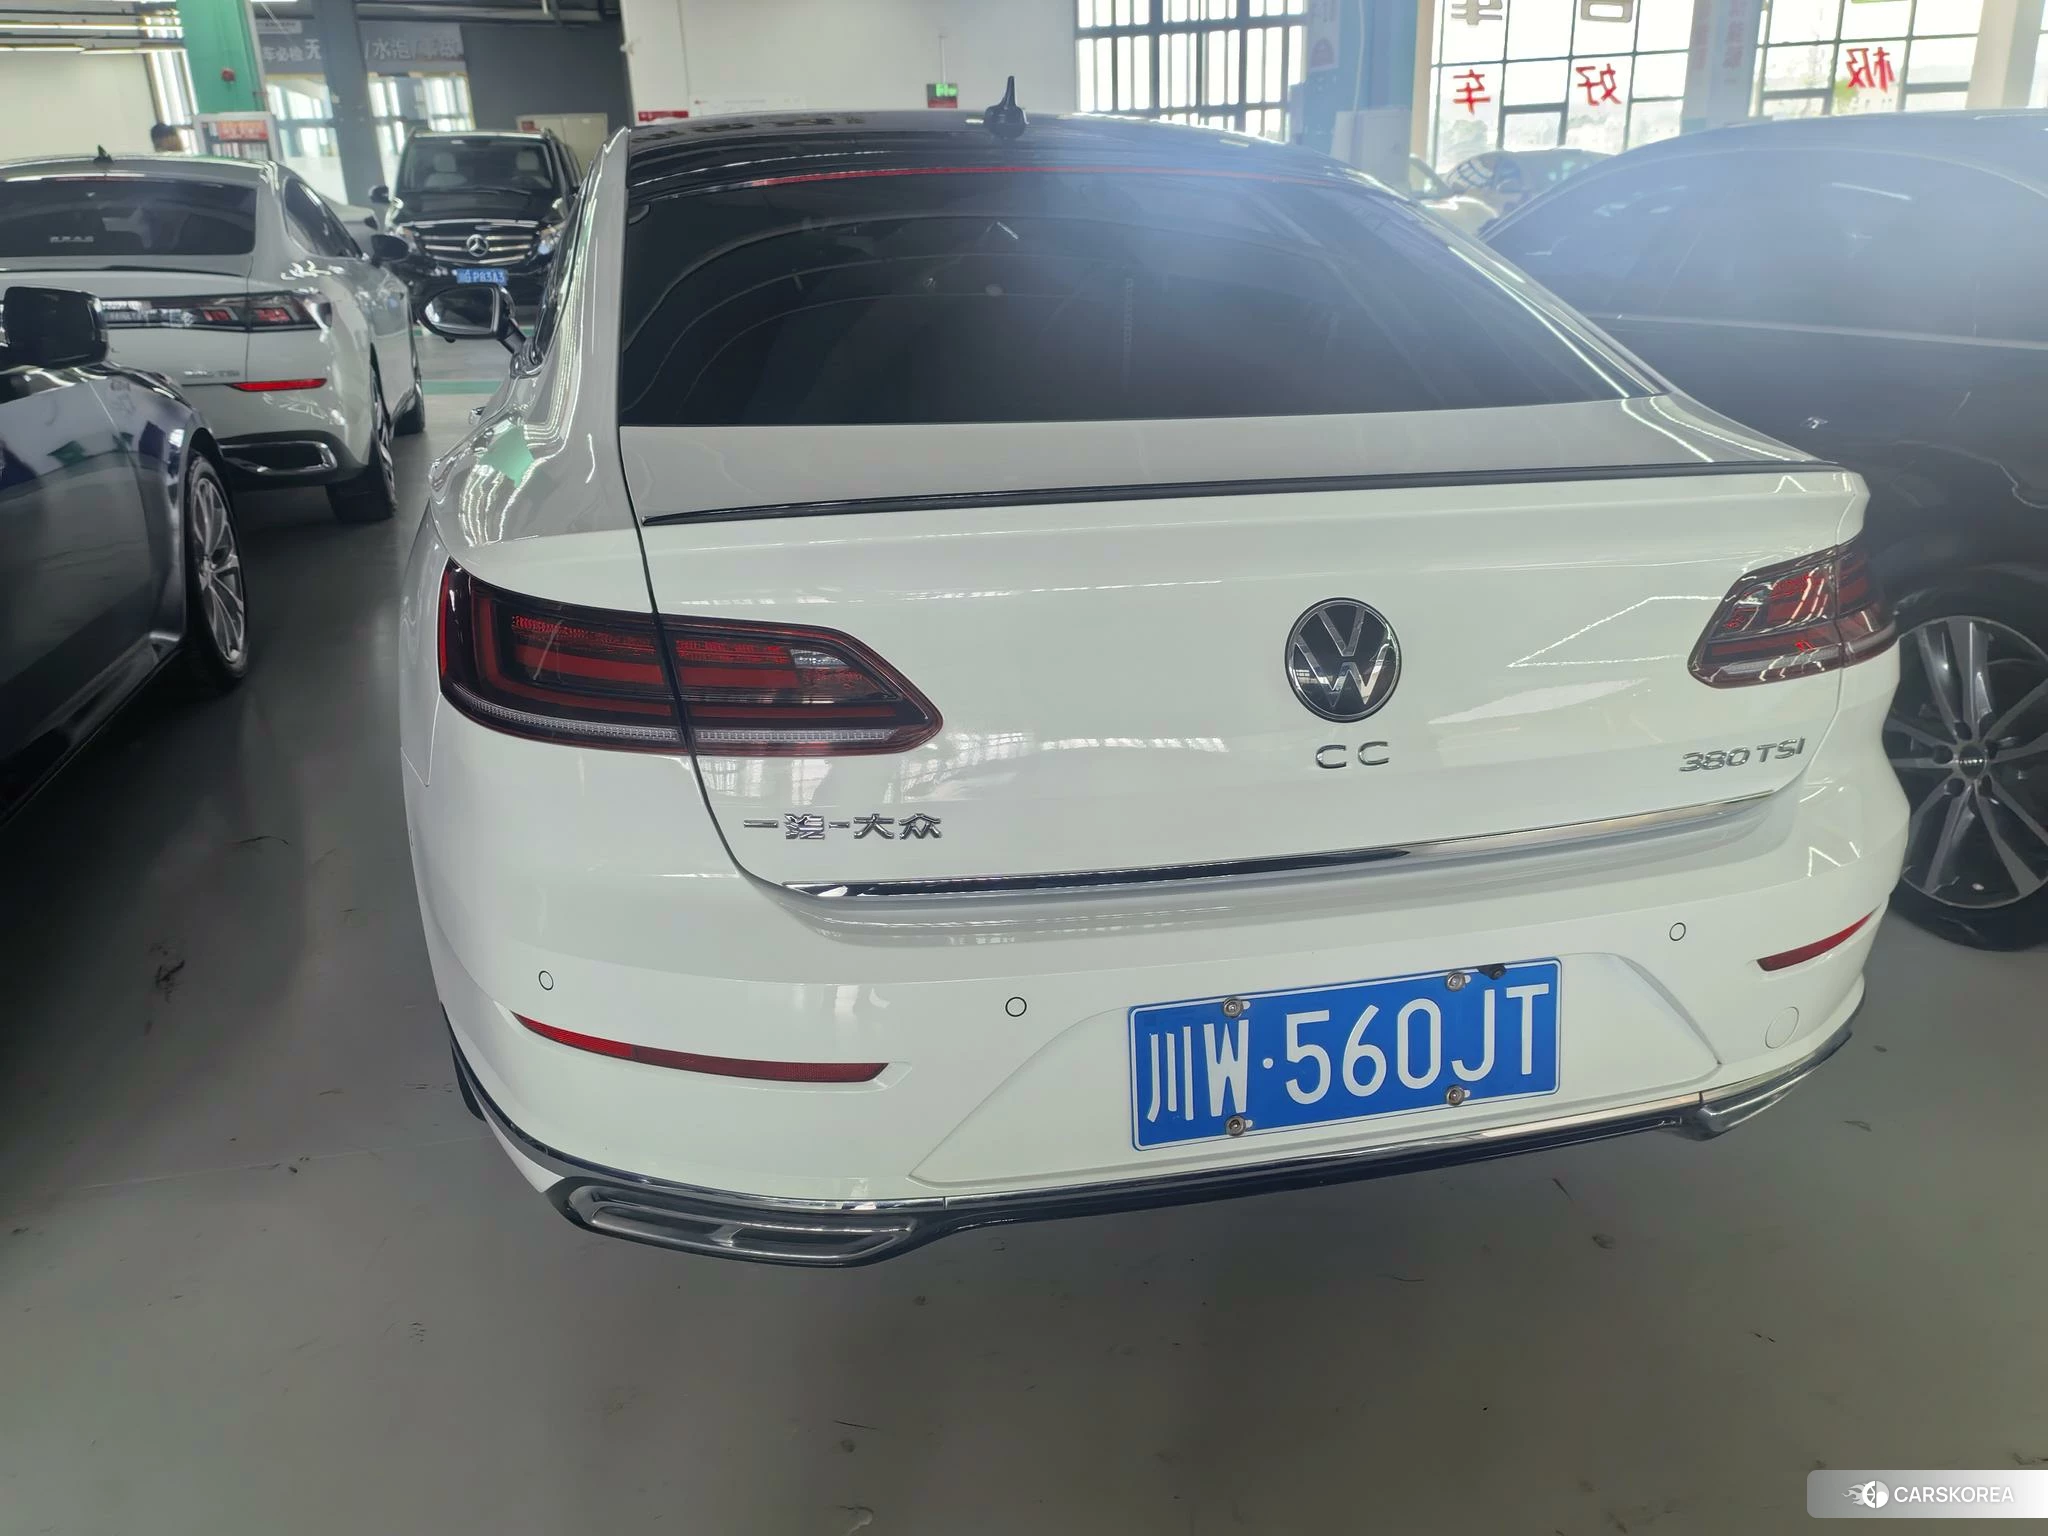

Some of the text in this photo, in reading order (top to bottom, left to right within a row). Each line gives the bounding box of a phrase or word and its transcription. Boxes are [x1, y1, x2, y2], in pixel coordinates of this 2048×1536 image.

[1316, 741, 1390, 769] CC
[1679, 736, 1806, 772] 380 TSI
